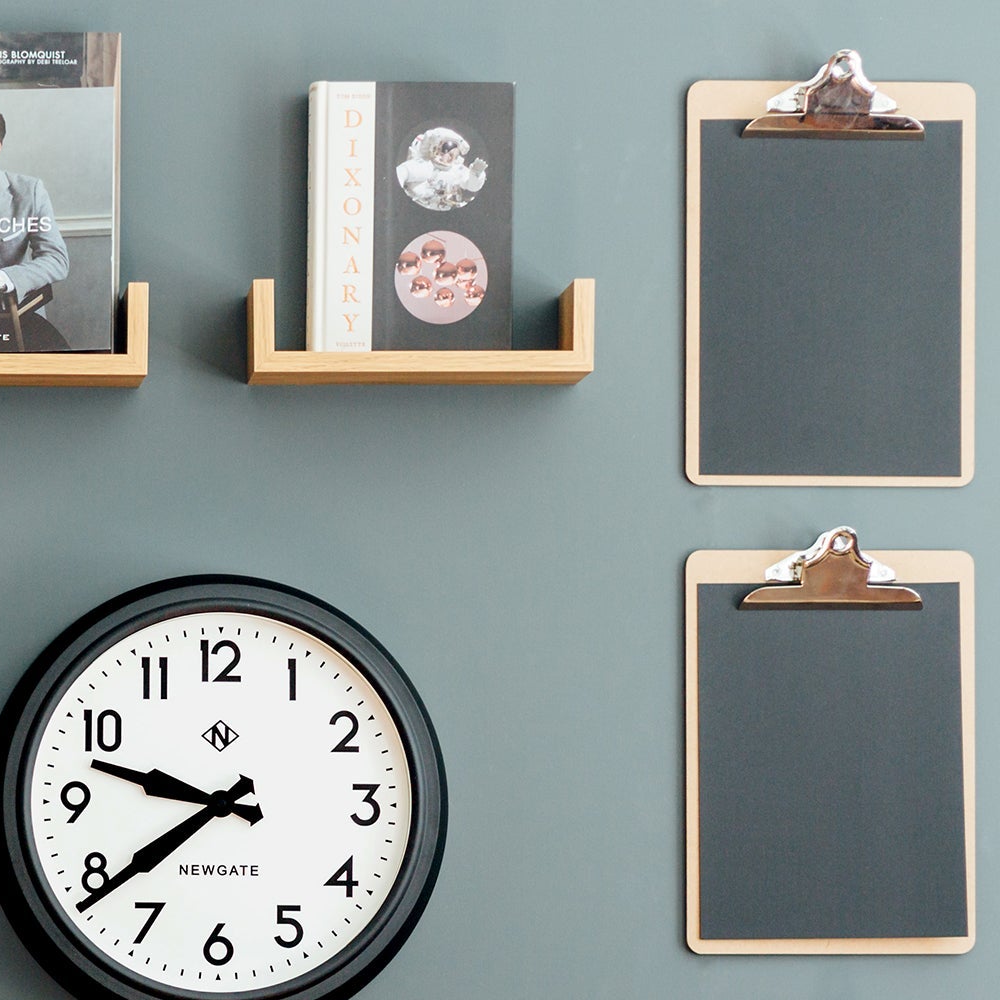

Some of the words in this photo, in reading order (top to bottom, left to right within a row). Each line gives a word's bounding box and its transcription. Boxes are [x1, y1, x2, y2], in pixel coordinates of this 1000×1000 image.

[11, 50, 66, 59] BLOMQUIST
[342, 109, 363, 332] DIXONARY
[141, 656, 168, 700] 11
[200, 640, 242, 682] 12
[288, 658, 297, 701] 1
[84, 709, 122, 752] 10
[329, 710, 360, 753] 2
[60, 781, 91, 824] 9
[350, 784, 381, 827] 3
[81, 852, 110, 896] 8
[178, 864, 259, 877] NEWGATE
[323, 854, 359, 898] 4
[133, 902, 167, 944] 7
[203, 923, 234, 966] 6
[274, 905, 304, 948] 5
